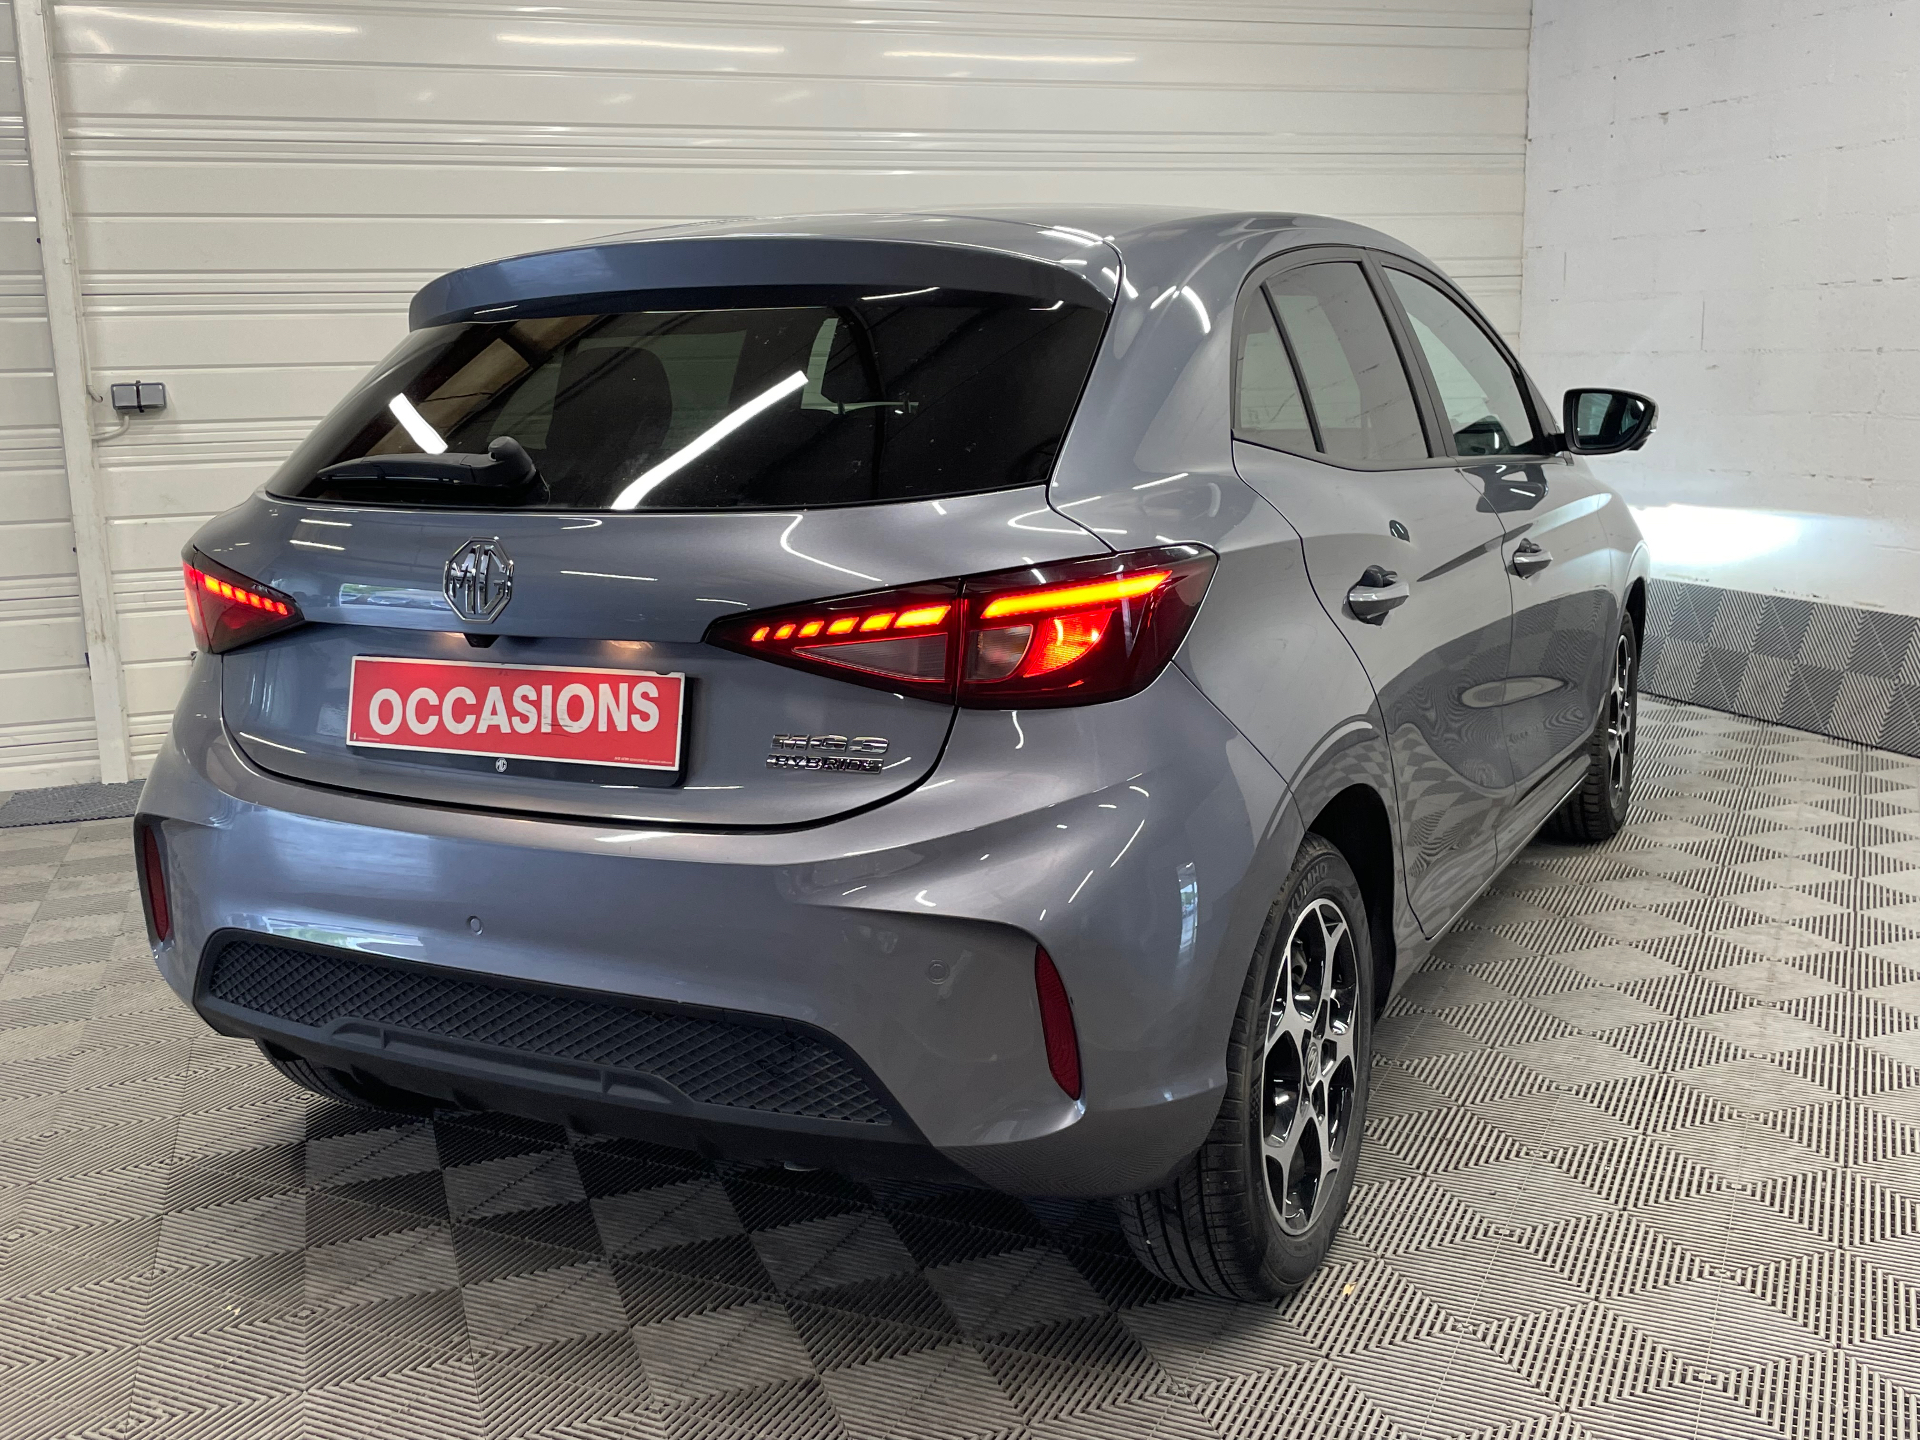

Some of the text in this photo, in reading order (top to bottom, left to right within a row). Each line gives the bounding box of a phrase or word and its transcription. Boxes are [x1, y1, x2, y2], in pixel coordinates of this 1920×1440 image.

[448, 543, 508, 616] MG
[369, 681, 660, 736] OCCASIONS
[771, 734, 889, 754] MG3
[1288, 862, 1328, 921] KUMHO
